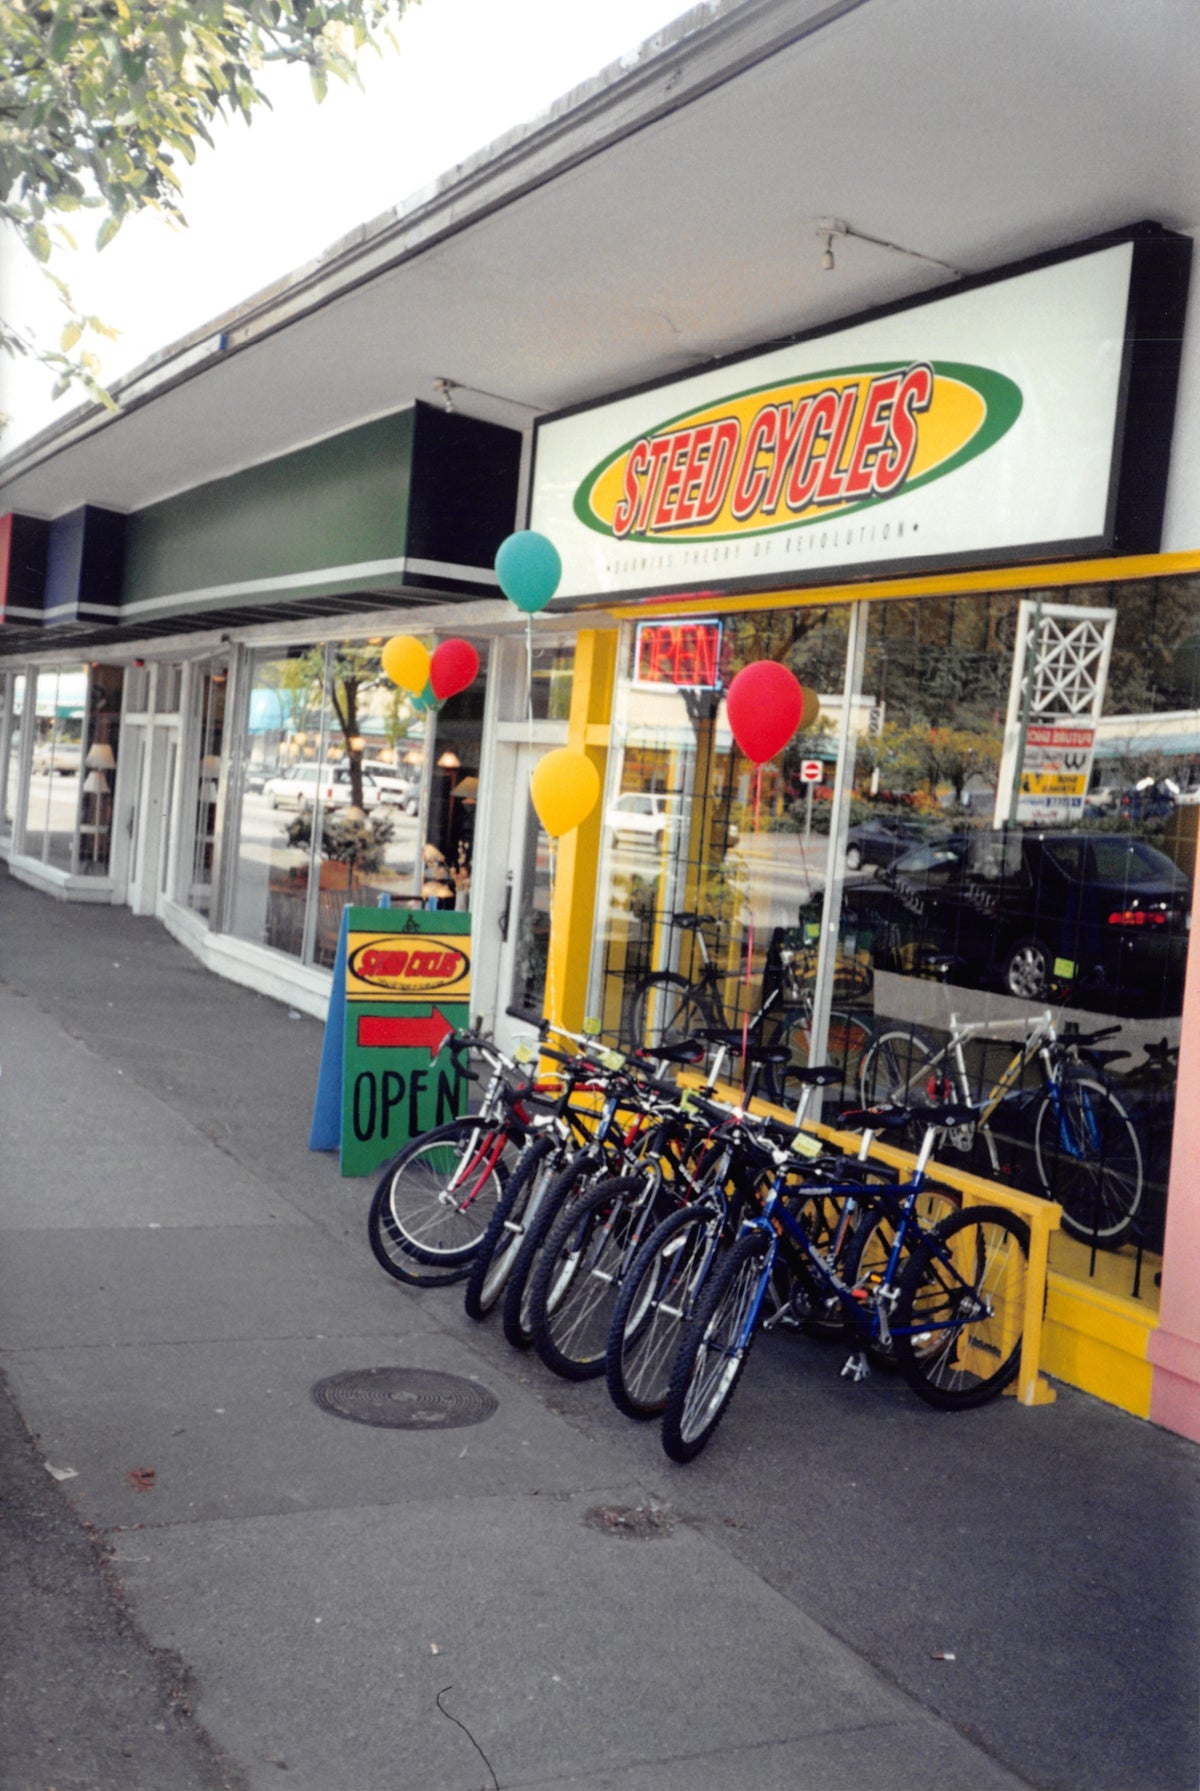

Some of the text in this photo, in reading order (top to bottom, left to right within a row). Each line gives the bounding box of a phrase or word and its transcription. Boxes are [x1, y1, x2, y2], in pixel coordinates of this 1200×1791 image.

[612, 361, 933, 541] STEED CYCLES
[683, 545, 741, 565] THEORY
[753, 540, 772, 557] OF
[786, 521, 906, 553] REVOLUTION
[638, 624, 718, 686] OPEN
[353, 1069, 461, 1141] OPEN
